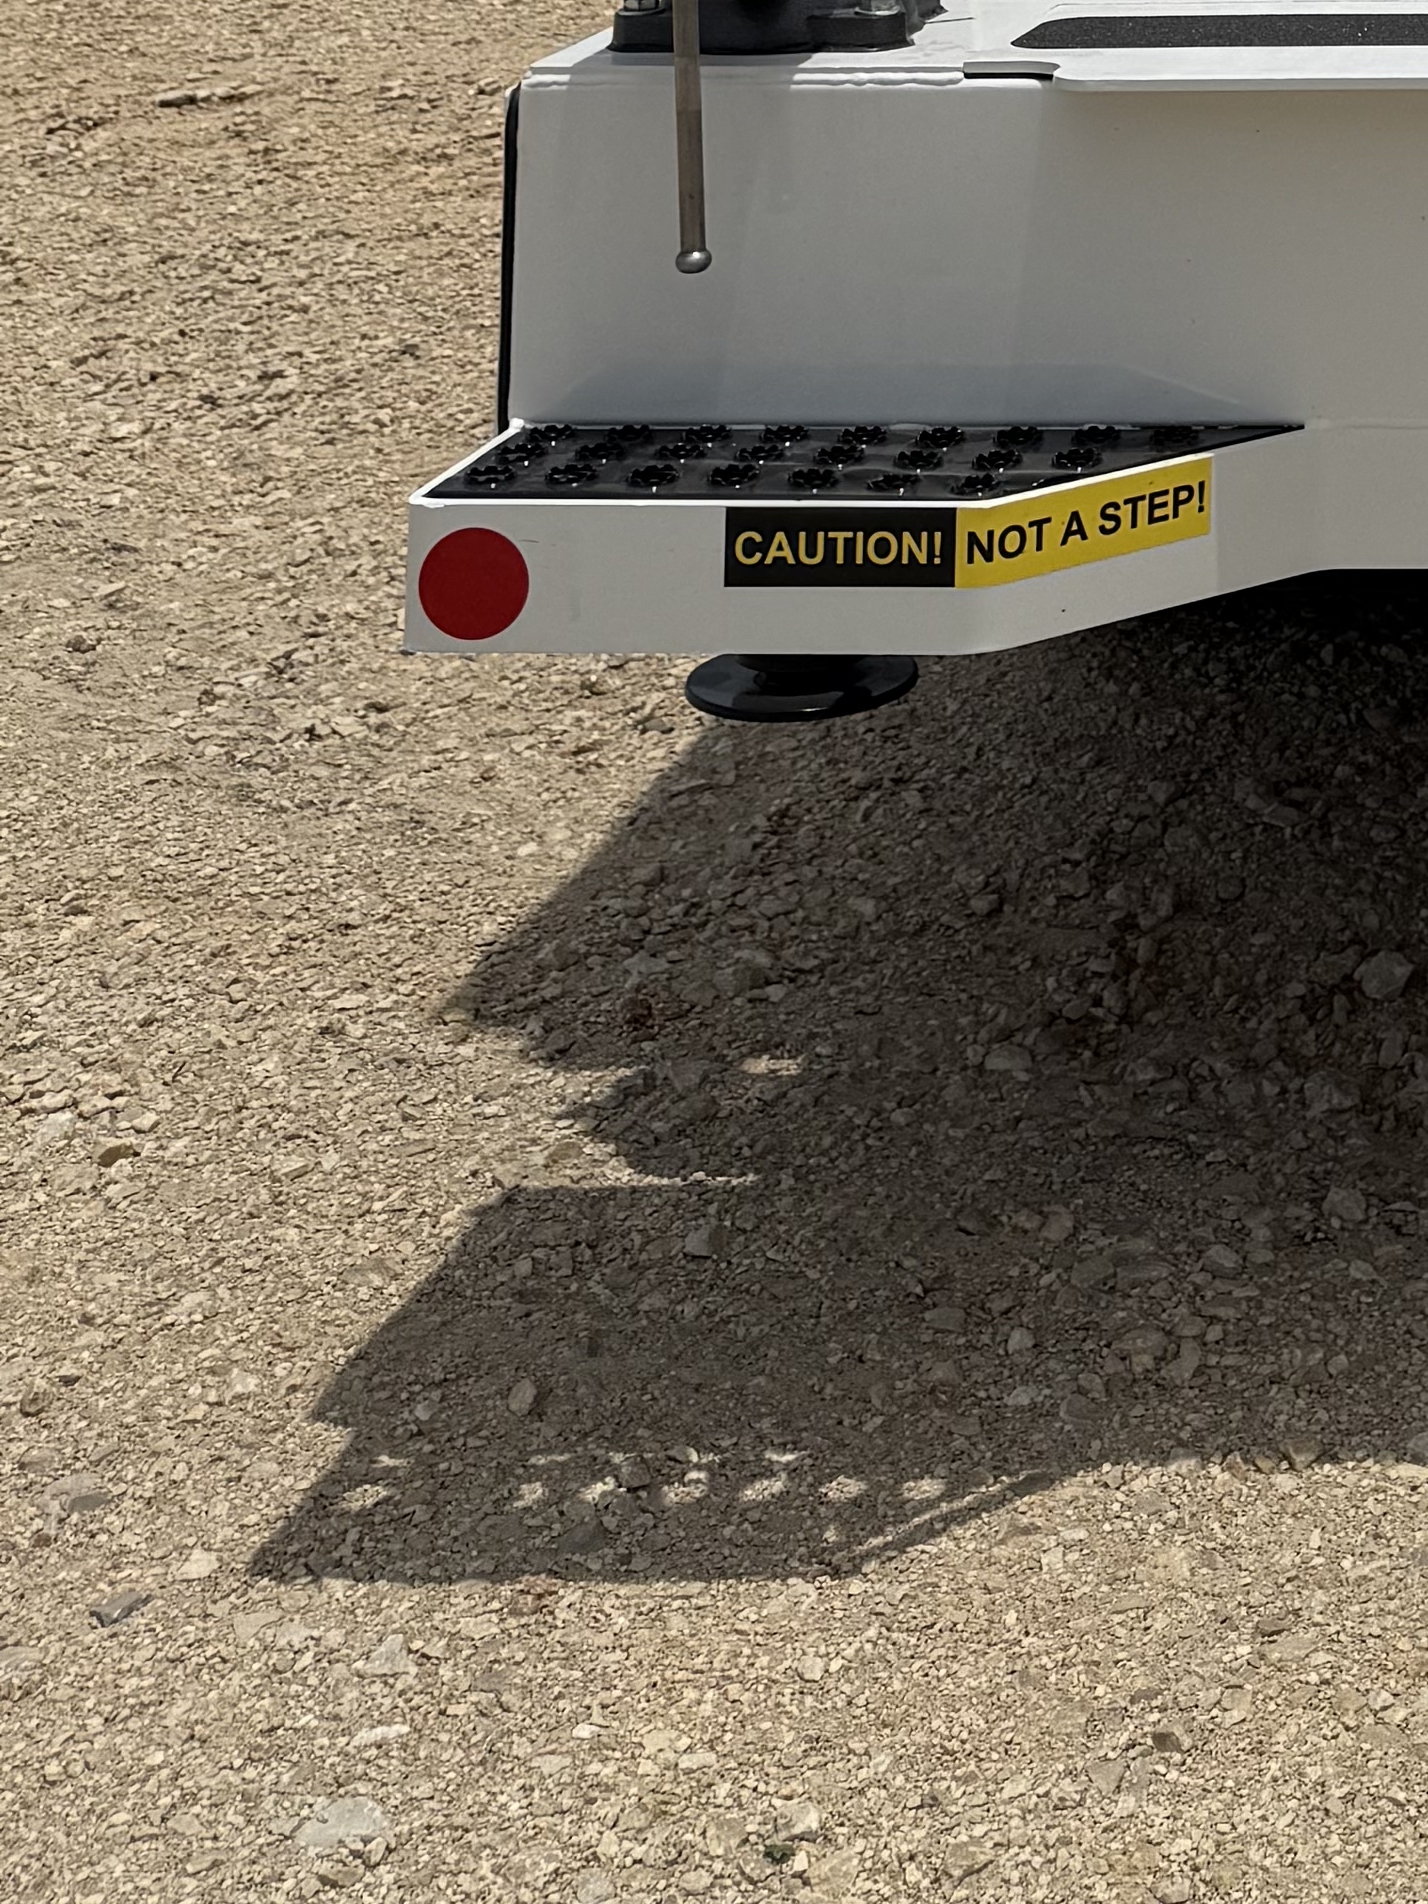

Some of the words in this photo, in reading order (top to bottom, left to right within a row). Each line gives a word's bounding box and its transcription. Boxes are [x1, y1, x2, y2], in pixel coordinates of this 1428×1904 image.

[734, 529, 942, 566] CAUTION!
[966, 516, 1052, 566] NOT
[1060, 510, 1089, 547] A
[1098, 480, 1206, 536] STEP!
